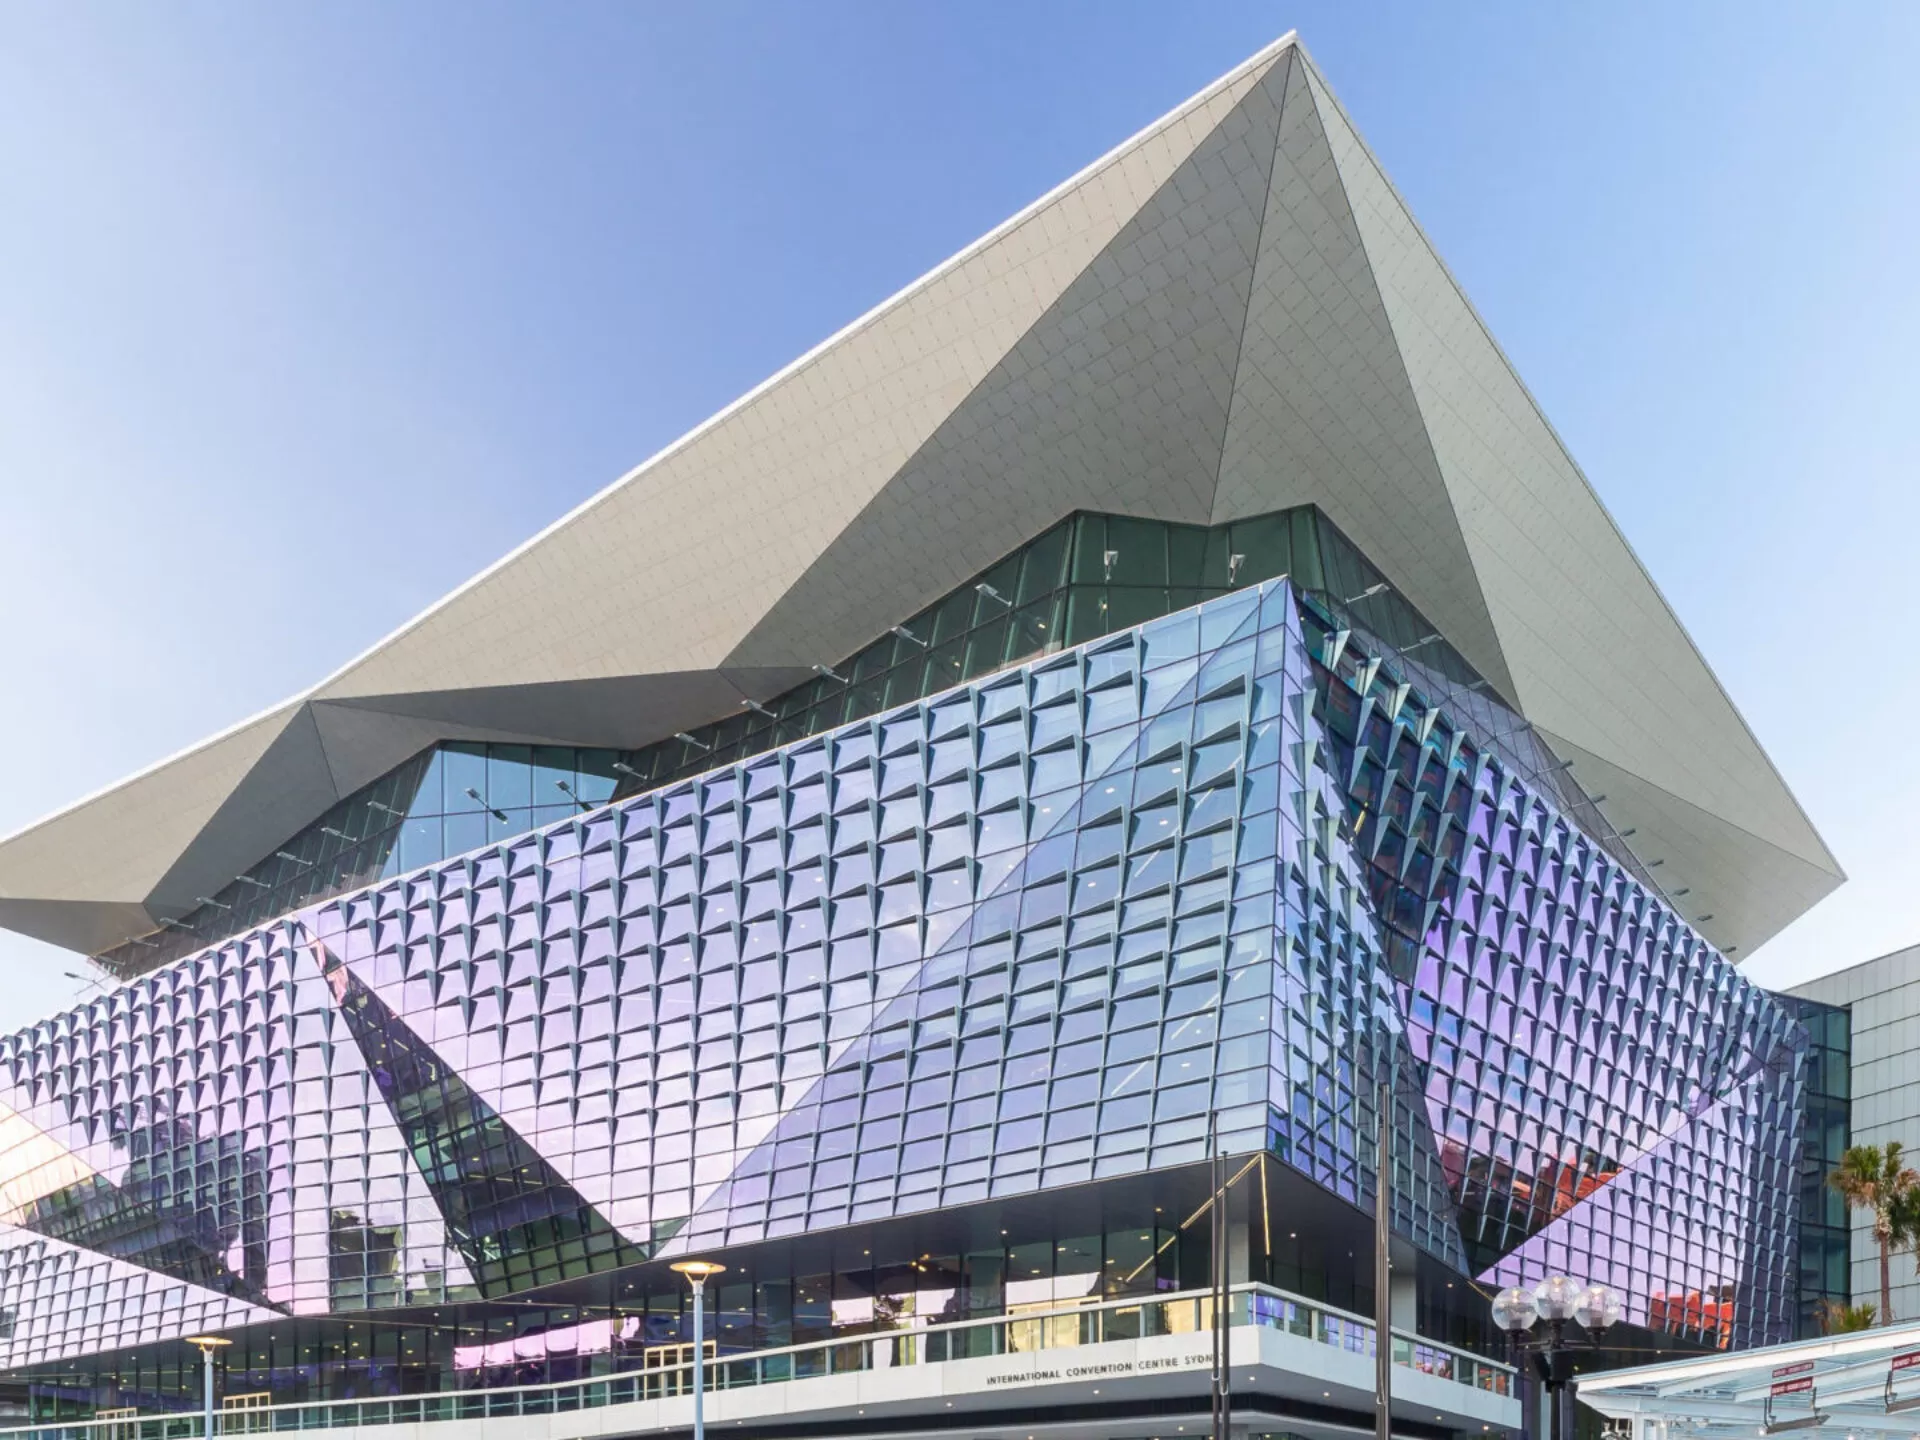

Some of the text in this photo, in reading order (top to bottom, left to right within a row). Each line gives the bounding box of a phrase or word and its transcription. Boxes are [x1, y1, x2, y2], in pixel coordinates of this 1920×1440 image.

[987, 1351, 1224, 1385] INTERNATIONAL CONVENTION CENTRE SYDN
